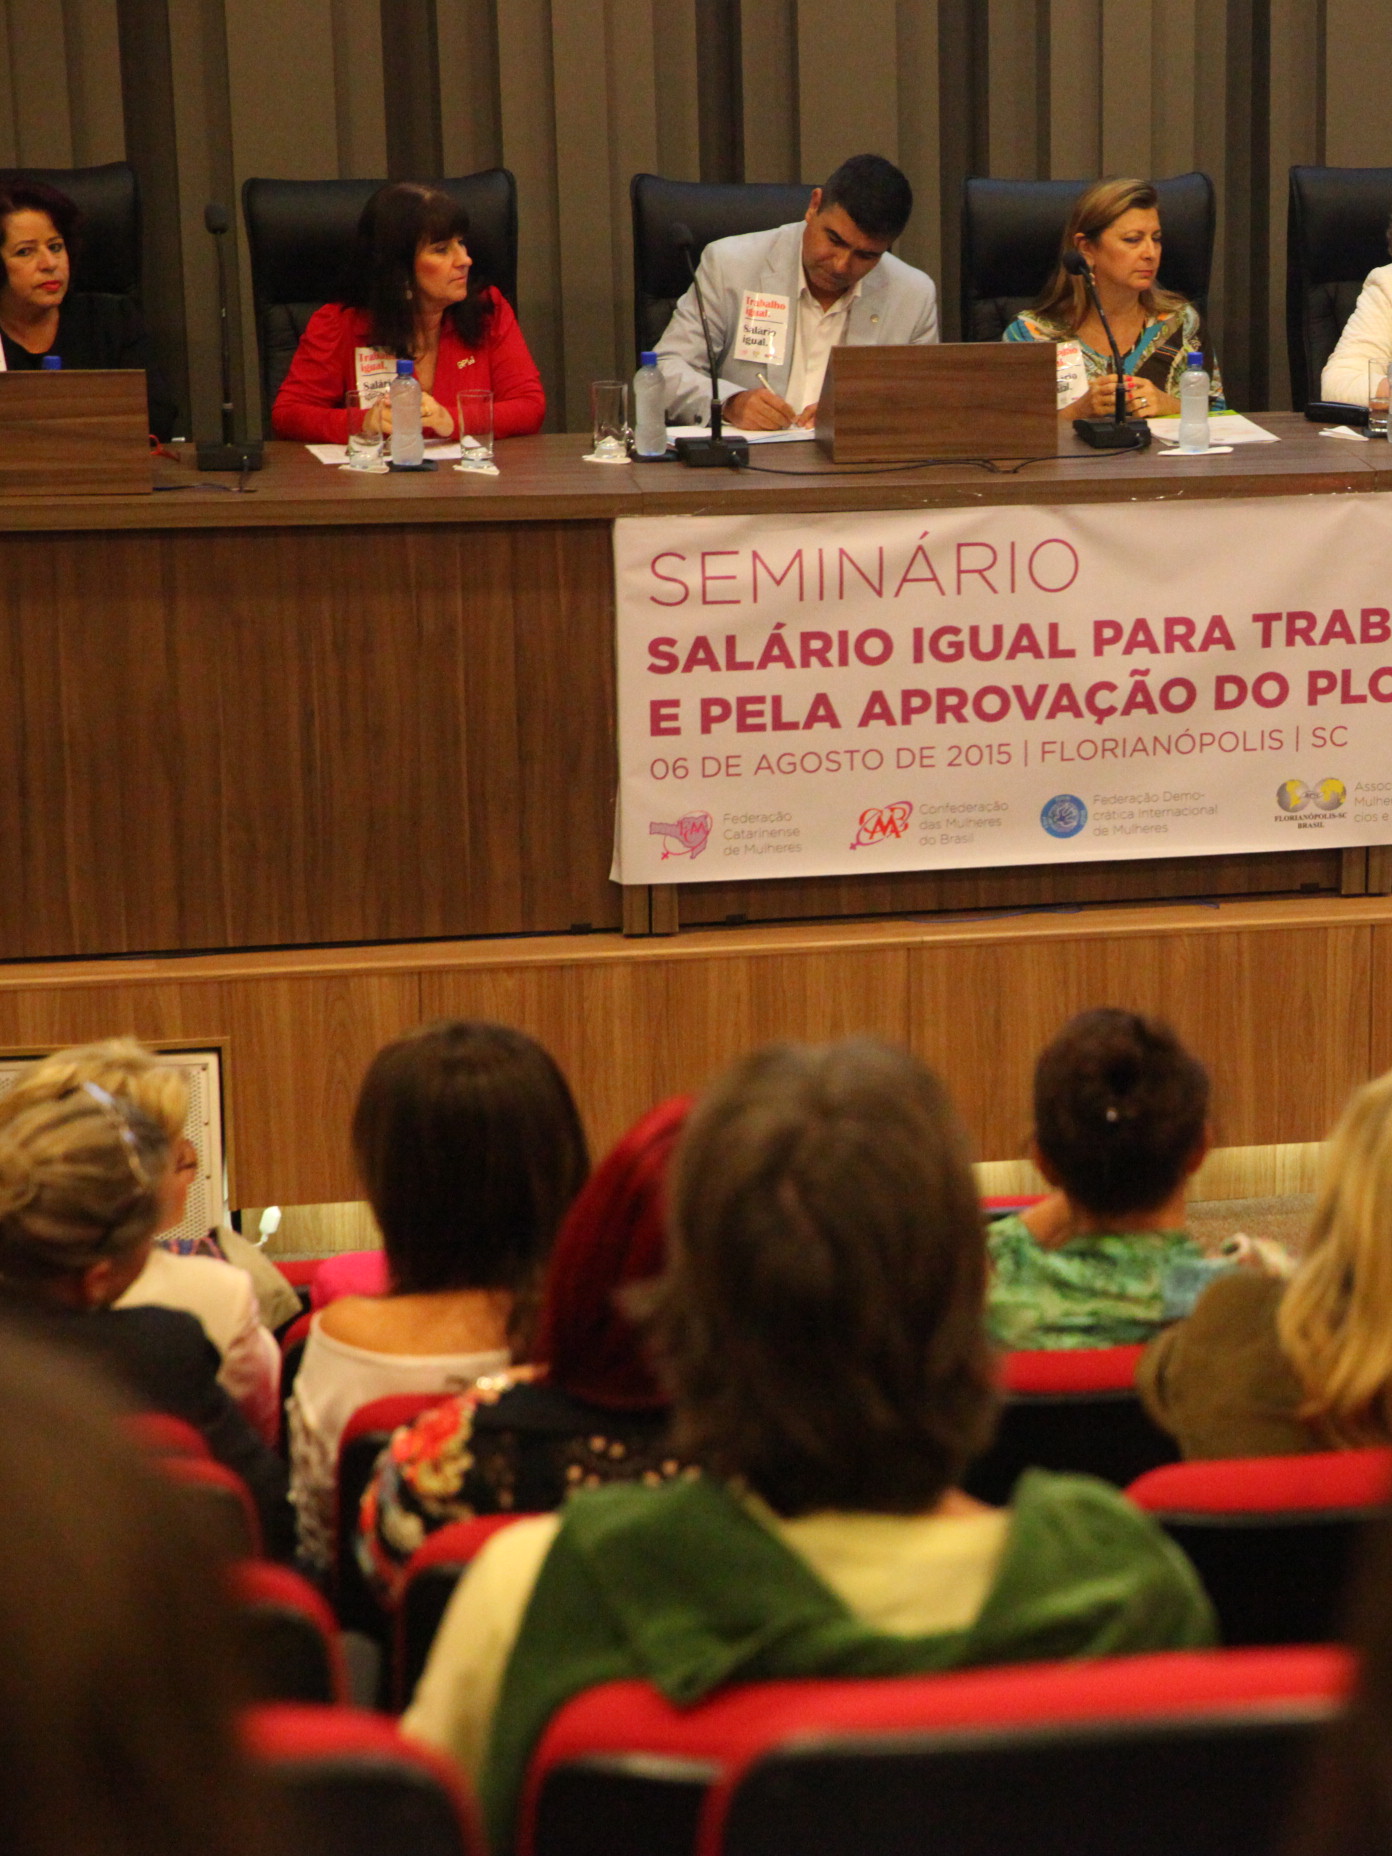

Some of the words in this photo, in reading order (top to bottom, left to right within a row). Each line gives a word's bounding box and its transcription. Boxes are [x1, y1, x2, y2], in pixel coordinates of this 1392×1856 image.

[746, 296, 786, 310] Trabalho
[746, 307, 771, 317] igual.
[744, 324, 776, 337] Salário
[743, 335, 769, 346] igual.
[363, 381, 391, 390] Salár
[649, 531, 1079, 607] SEMINÁRIO
[647, 623, 894, 676] SALÁRIO
[912, 622, 1076, 664] IGUAL
[1093, 615, 1235, 656] PARA
[650, 699, 681, 737] E
[700, 692, 842, 735] PELA
[857, 668, 1197, 728] APROVAÇÃO
[1214, 671, 1290, 711] DO
[650, 757, 690, 780] 06
[701, 755, 743, 778] DE
[754, 749, 885, 776] AGOSTO
[896, 746, 936, 769] DE
[947, 743, 1013, 768] 2015
[1041, 727, 1285, 763] FLORIANÓPOLIS
[1311, 724, 1348, 748] SC
[1093, 792, 1159, 806] Federação
[1163, 790, 1206, 803] Demo-
[919, 801, 1009, 816] Confederação
[1093, 808, 1135, 821] crática
[1138, 804, 1218, 819] Internacional
[723, 811, 793, 825] Federação
[919, 818, 942, 831] das
[946, 817, 1002, 829] Mulheres
[1354, 811, 1378, 823] cios
[1381, 813, 1389, 821] e
[723, 826, 802, 841] Catarinense
[1093, 824, 1109, 837] de
[1113, 823, 1169, 835] Mulheres
[919, 835, 936, 846] do
[940, 833, 974, 845] Brasil
[723, 844, 740, 857] de
[744, 842, 802, 855] Mulheres
